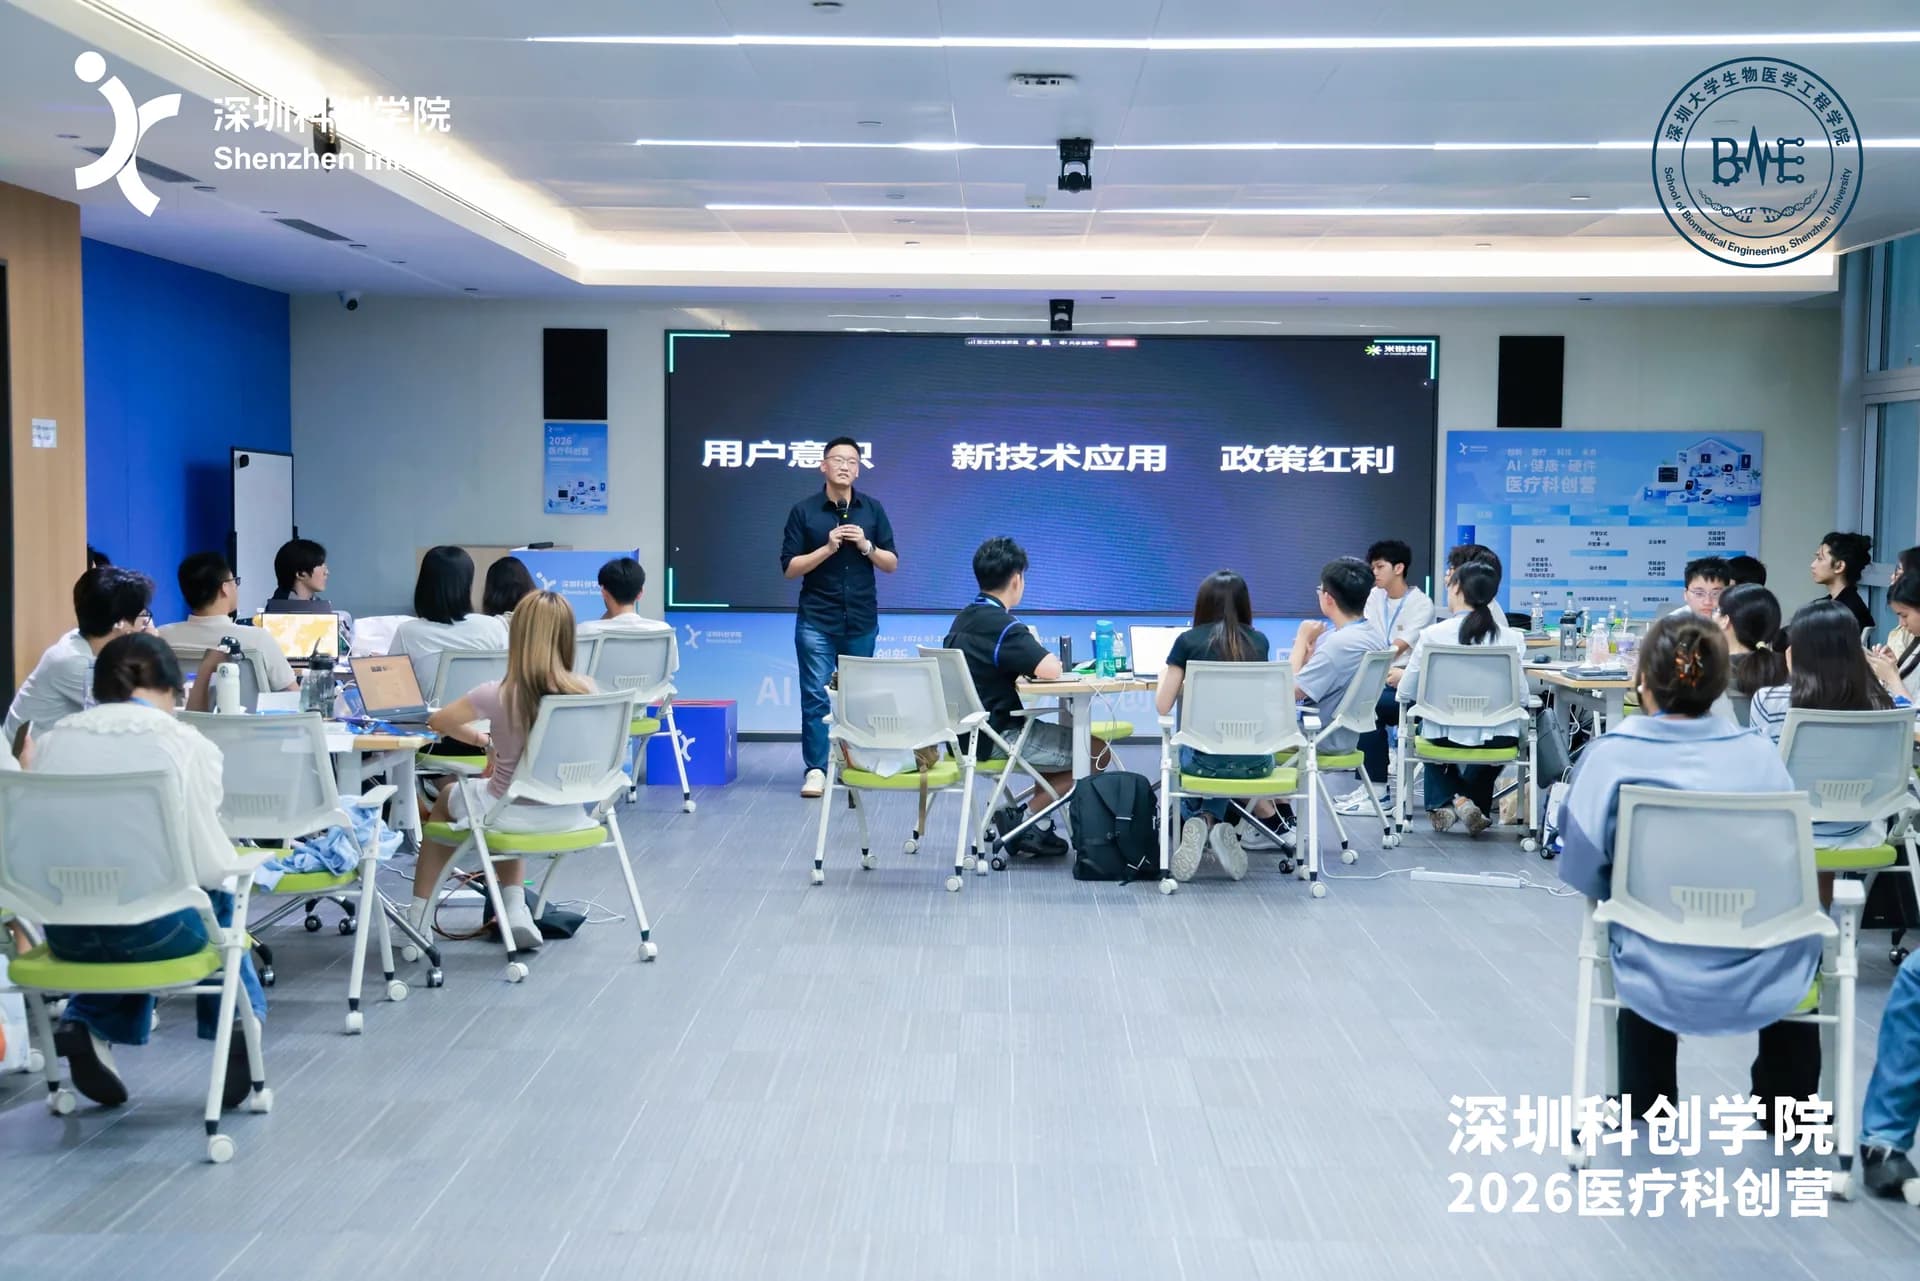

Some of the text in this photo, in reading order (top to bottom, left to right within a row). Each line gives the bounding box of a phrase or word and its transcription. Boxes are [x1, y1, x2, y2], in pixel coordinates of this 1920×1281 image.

[951, 442, 1168, 472] 新技术应用
[1220, 444, 1395, 474] 政策红利
[1505, 475, 1597, 494] 医疗科创营
